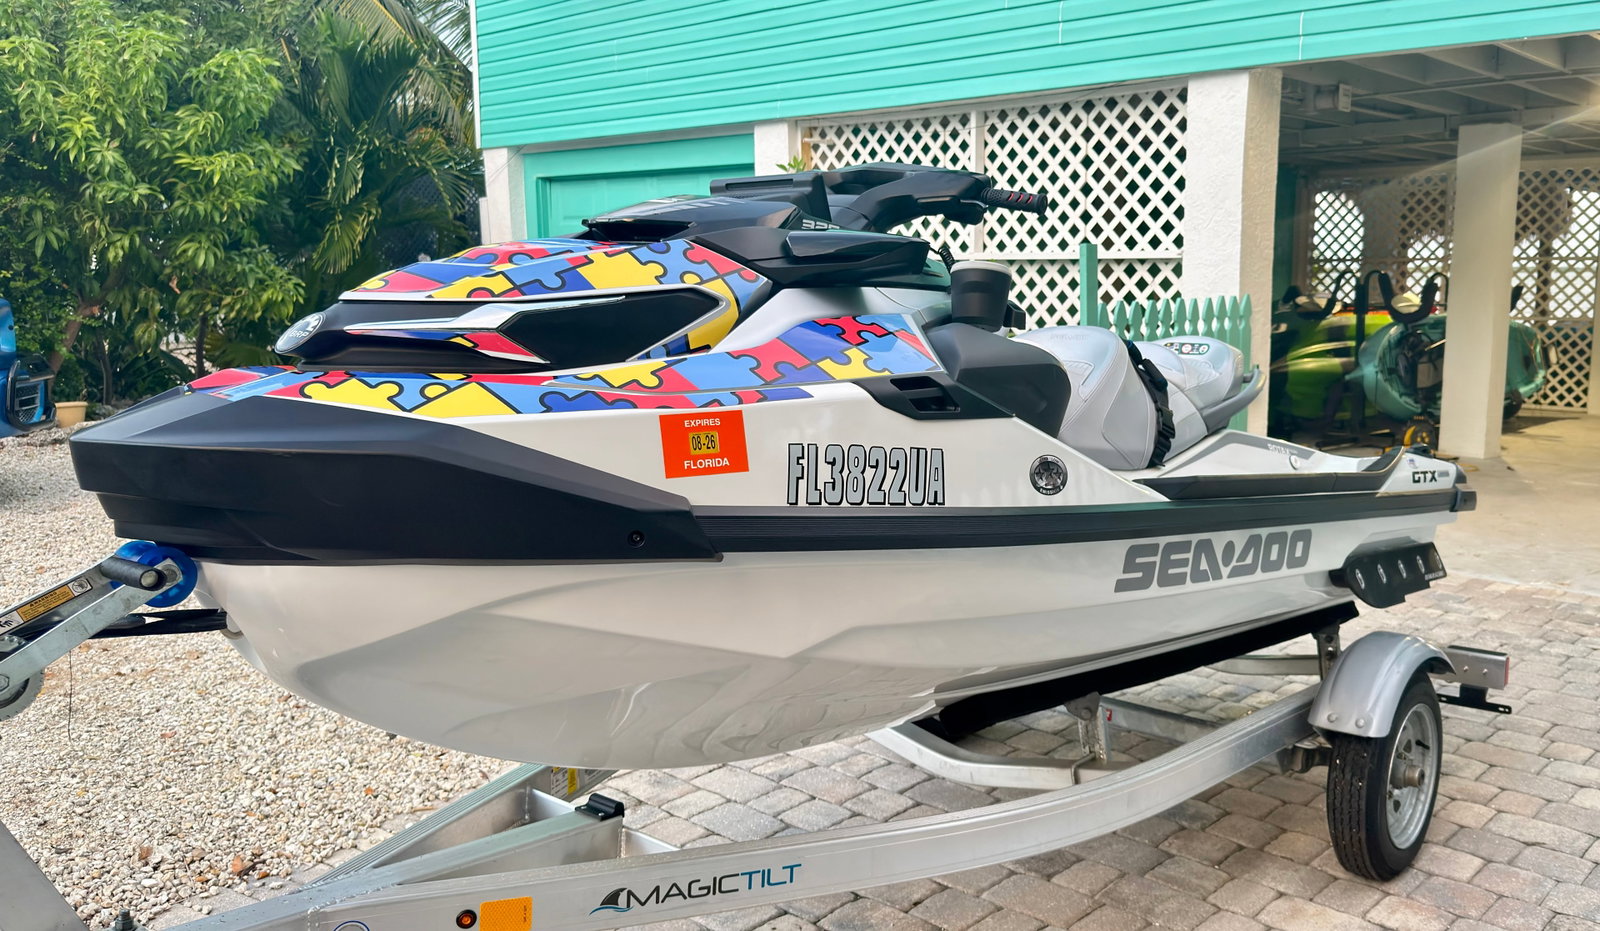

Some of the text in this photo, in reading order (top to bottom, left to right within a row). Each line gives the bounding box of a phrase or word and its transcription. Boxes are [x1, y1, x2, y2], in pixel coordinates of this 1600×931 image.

[684, 418, 721, 427] EXPIRES
[691, 435, 716, 451] 08-26
[684, 458, 730, 469] FLORIDA
[787, 443, 946, 506] FL3822UA
[1412, 470, 1437, 484] GTX
[626, 863, 802, 909] MAGICTILT
